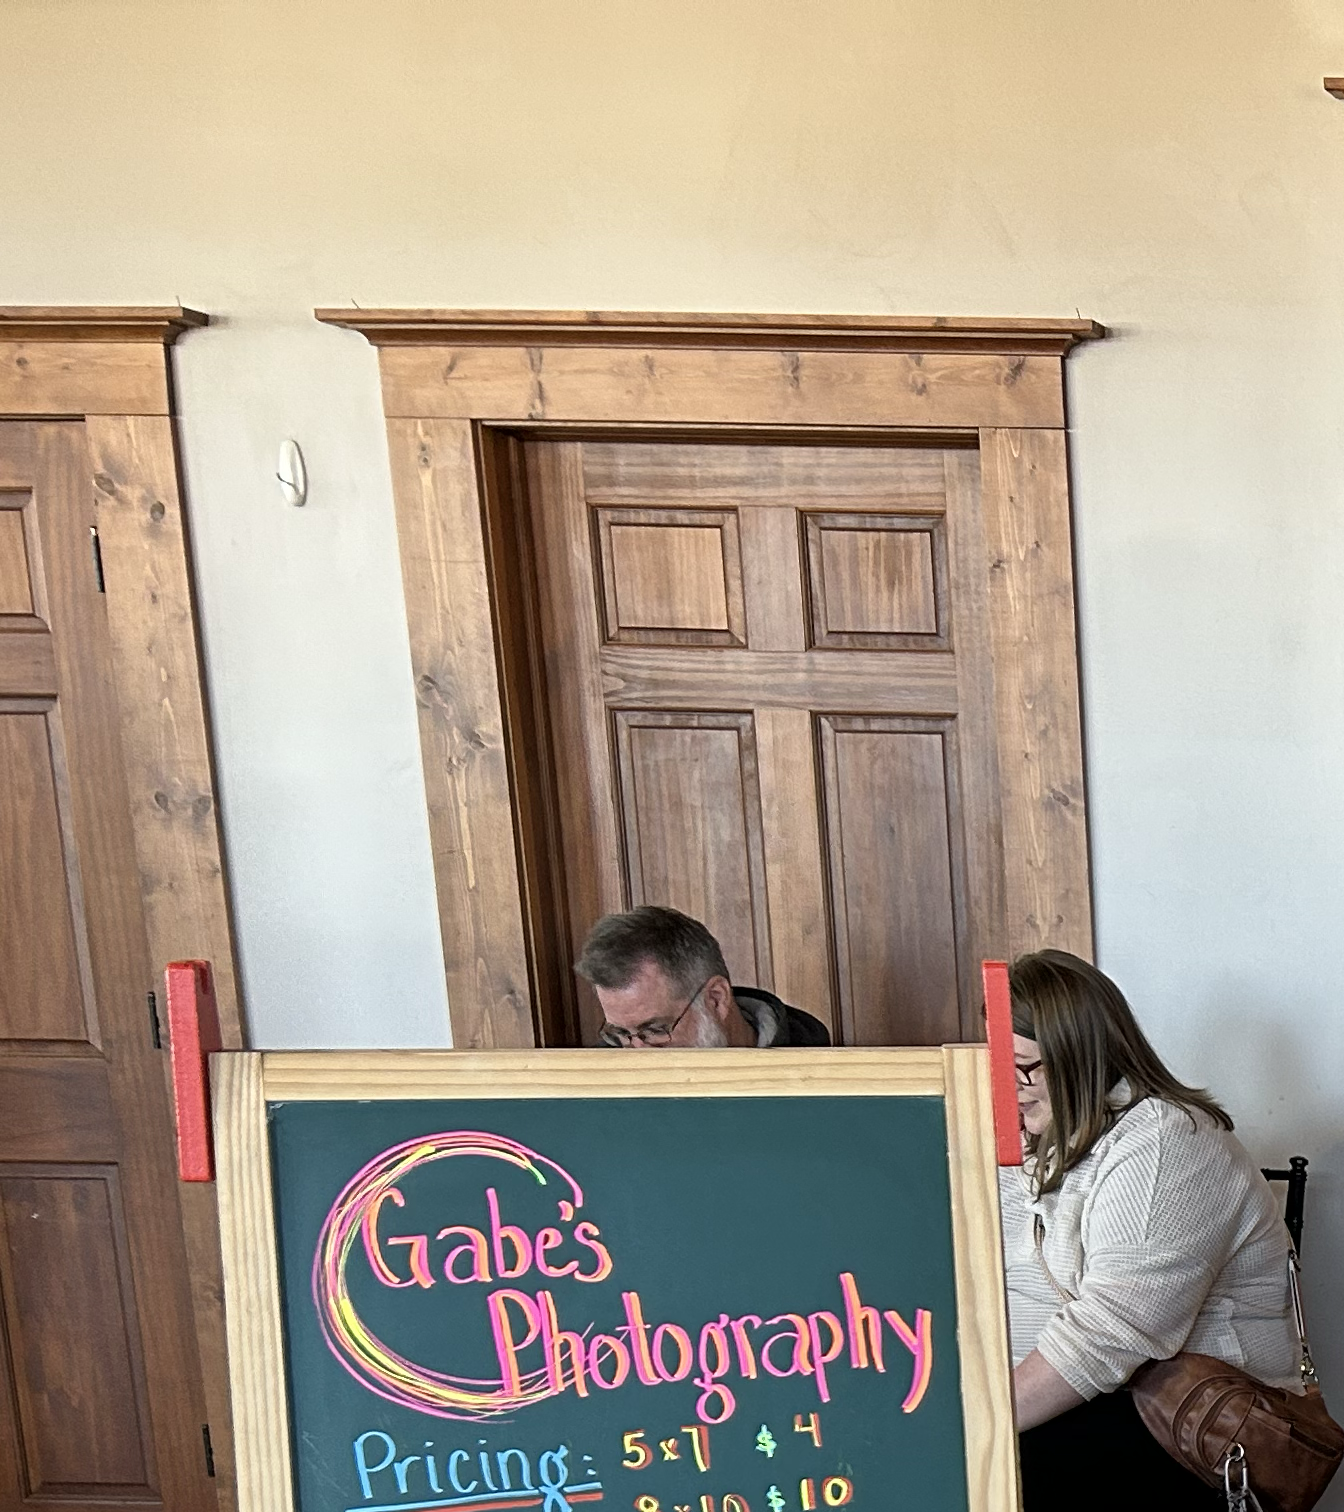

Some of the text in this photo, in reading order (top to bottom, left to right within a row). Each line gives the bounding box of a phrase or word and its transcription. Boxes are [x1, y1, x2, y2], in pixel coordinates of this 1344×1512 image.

[361, 1187, 614, 1288] Gabe's
[486, 1272, 932, 1424] Photography
[793, 1412, 823, 1448] 4
